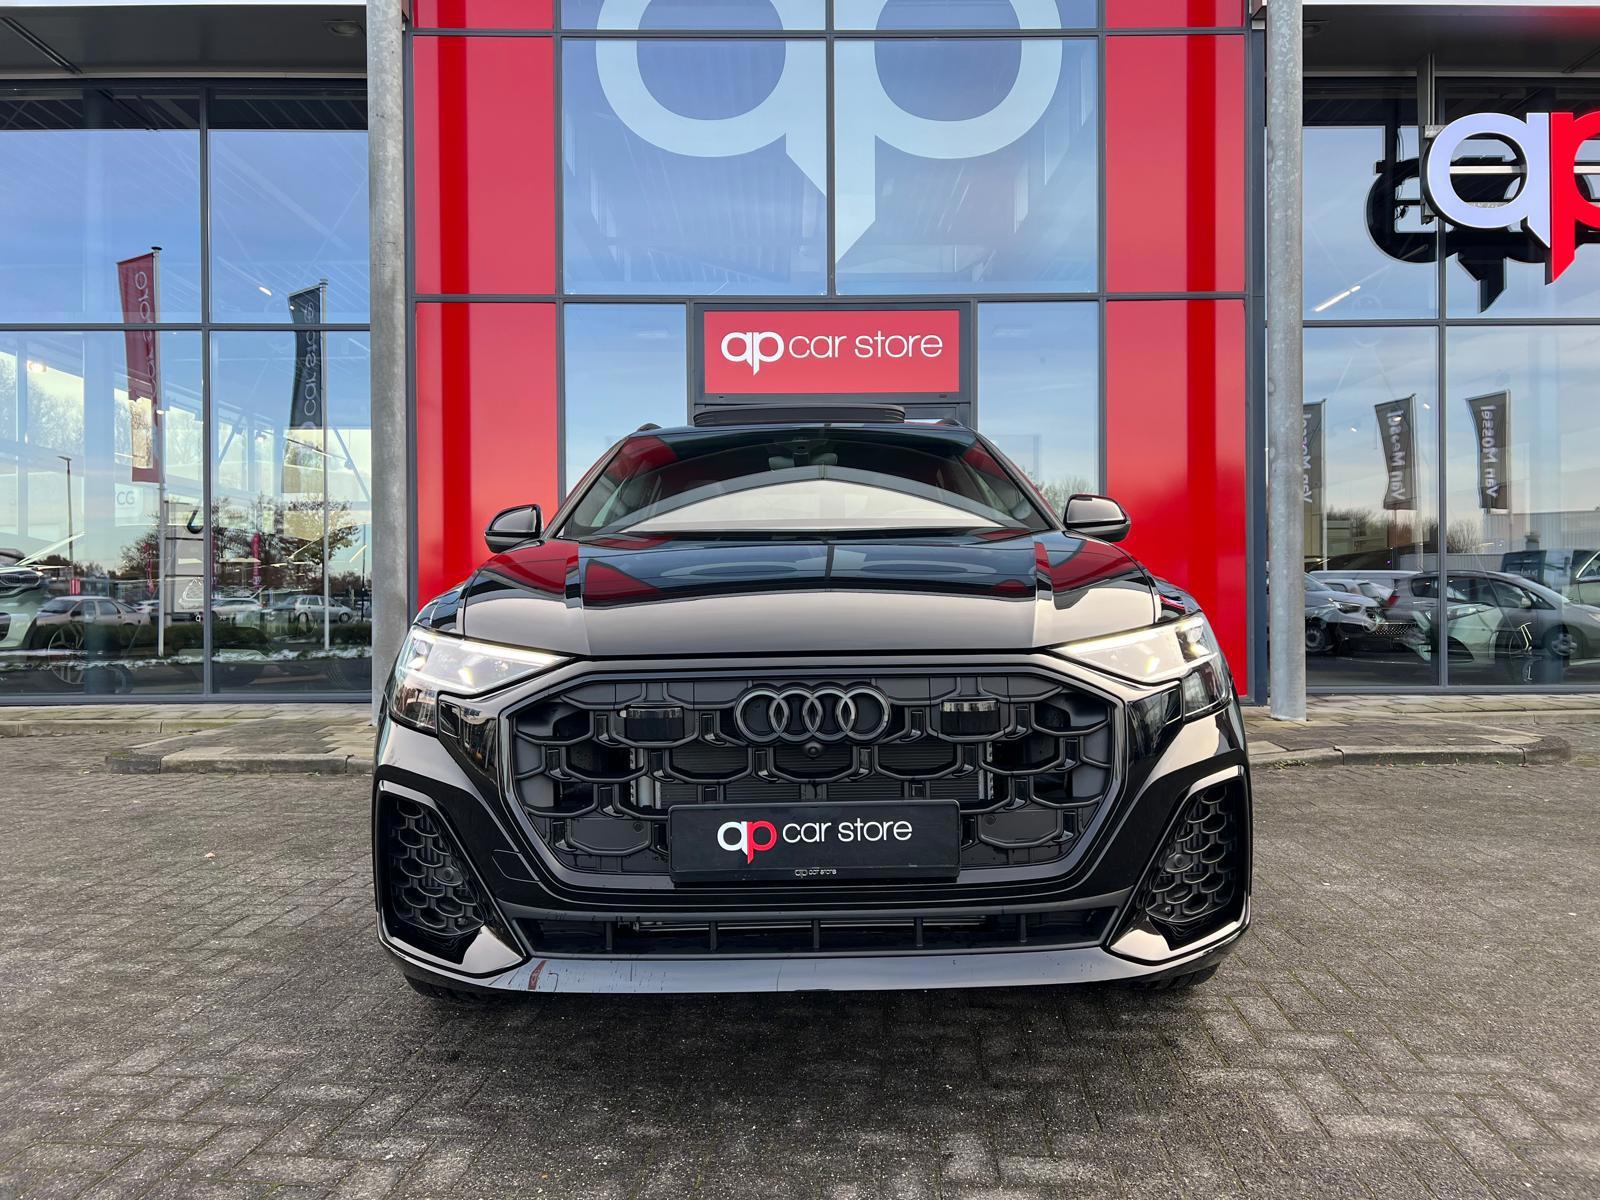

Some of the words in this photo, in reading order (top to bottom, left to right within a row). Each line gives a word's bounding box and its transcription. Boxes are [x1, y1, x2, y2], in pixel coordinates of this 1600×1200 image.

[721, 331, 785, 376] ap
[788, 334, 848, 359] car
[854, 330, 944, 359] store
[717, 820, 778, 864] ap
[782, 822, 832, 843] car
[837, 817, 913, 842] store
